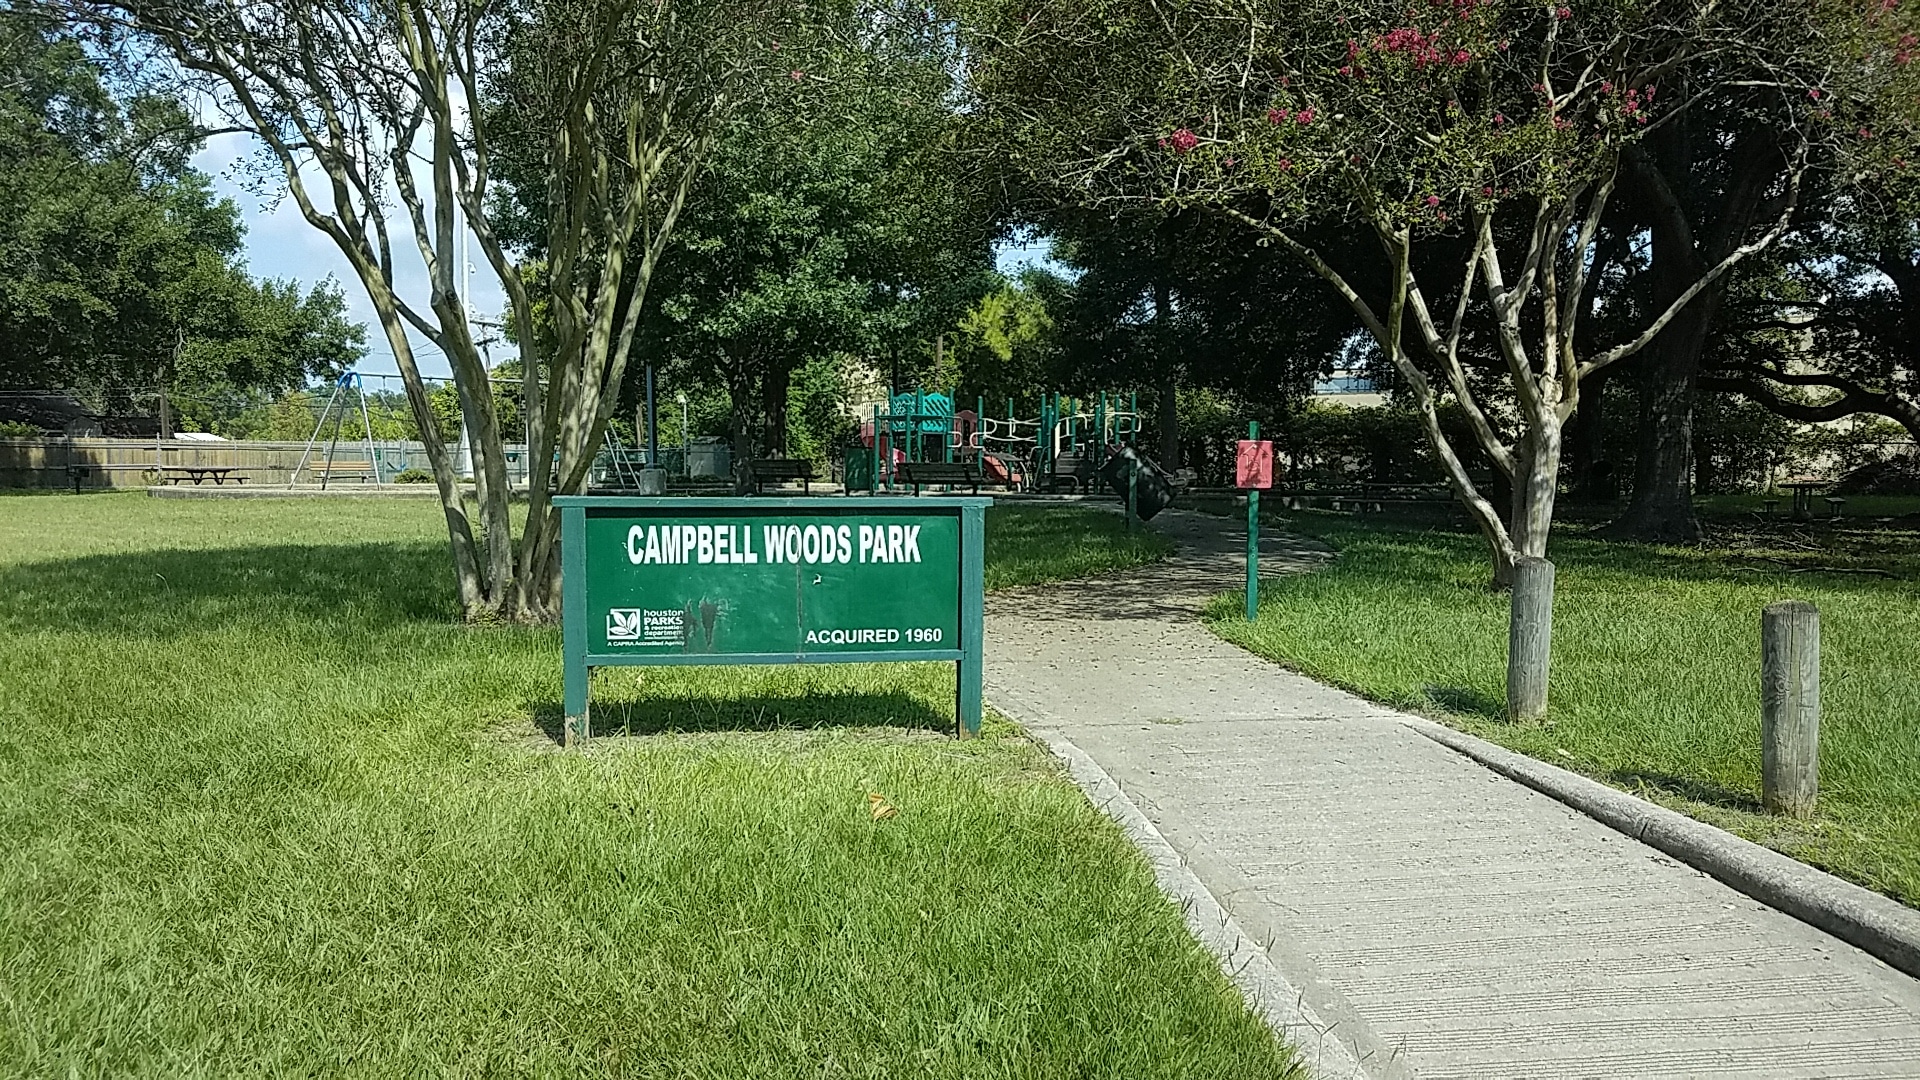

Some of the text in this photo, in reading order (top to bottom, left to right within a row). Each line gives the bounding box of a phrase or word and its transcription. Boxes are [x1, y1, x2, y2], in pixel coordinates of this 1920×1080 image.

[627, 524, 922, 565] CAMPBELL WOODS PARK
[644, 617, 684, 626] PARKS
[806, 628, 943, 644] ACQUIRED 1960
